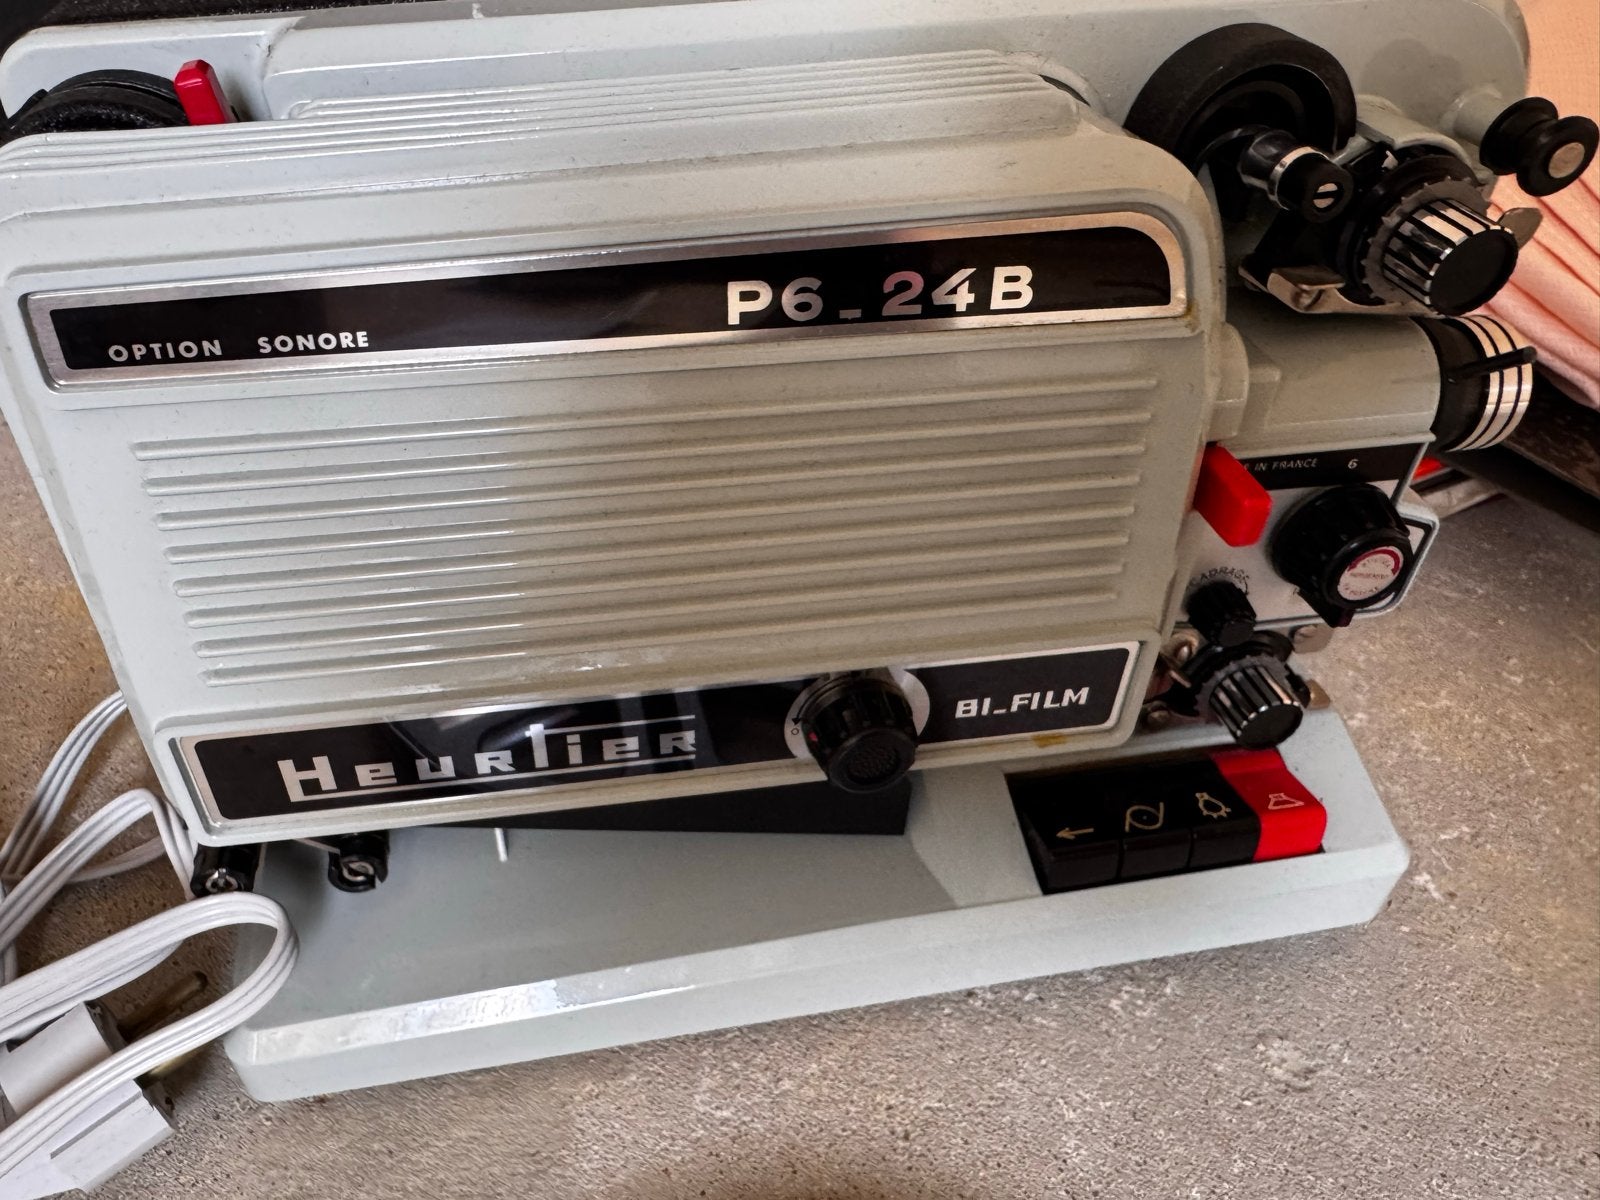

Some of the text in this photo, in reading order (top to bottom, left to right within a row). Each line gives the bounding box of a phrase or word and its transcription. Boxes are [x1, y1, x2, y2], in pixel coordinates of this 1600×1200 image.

[107, 330, 370, 362] OPTION SONORE
[1254, 461, 1267, 472] IN
[1271, 457, 1318, 471] FRANCE
[1347, 458, 1359, 470] 6
